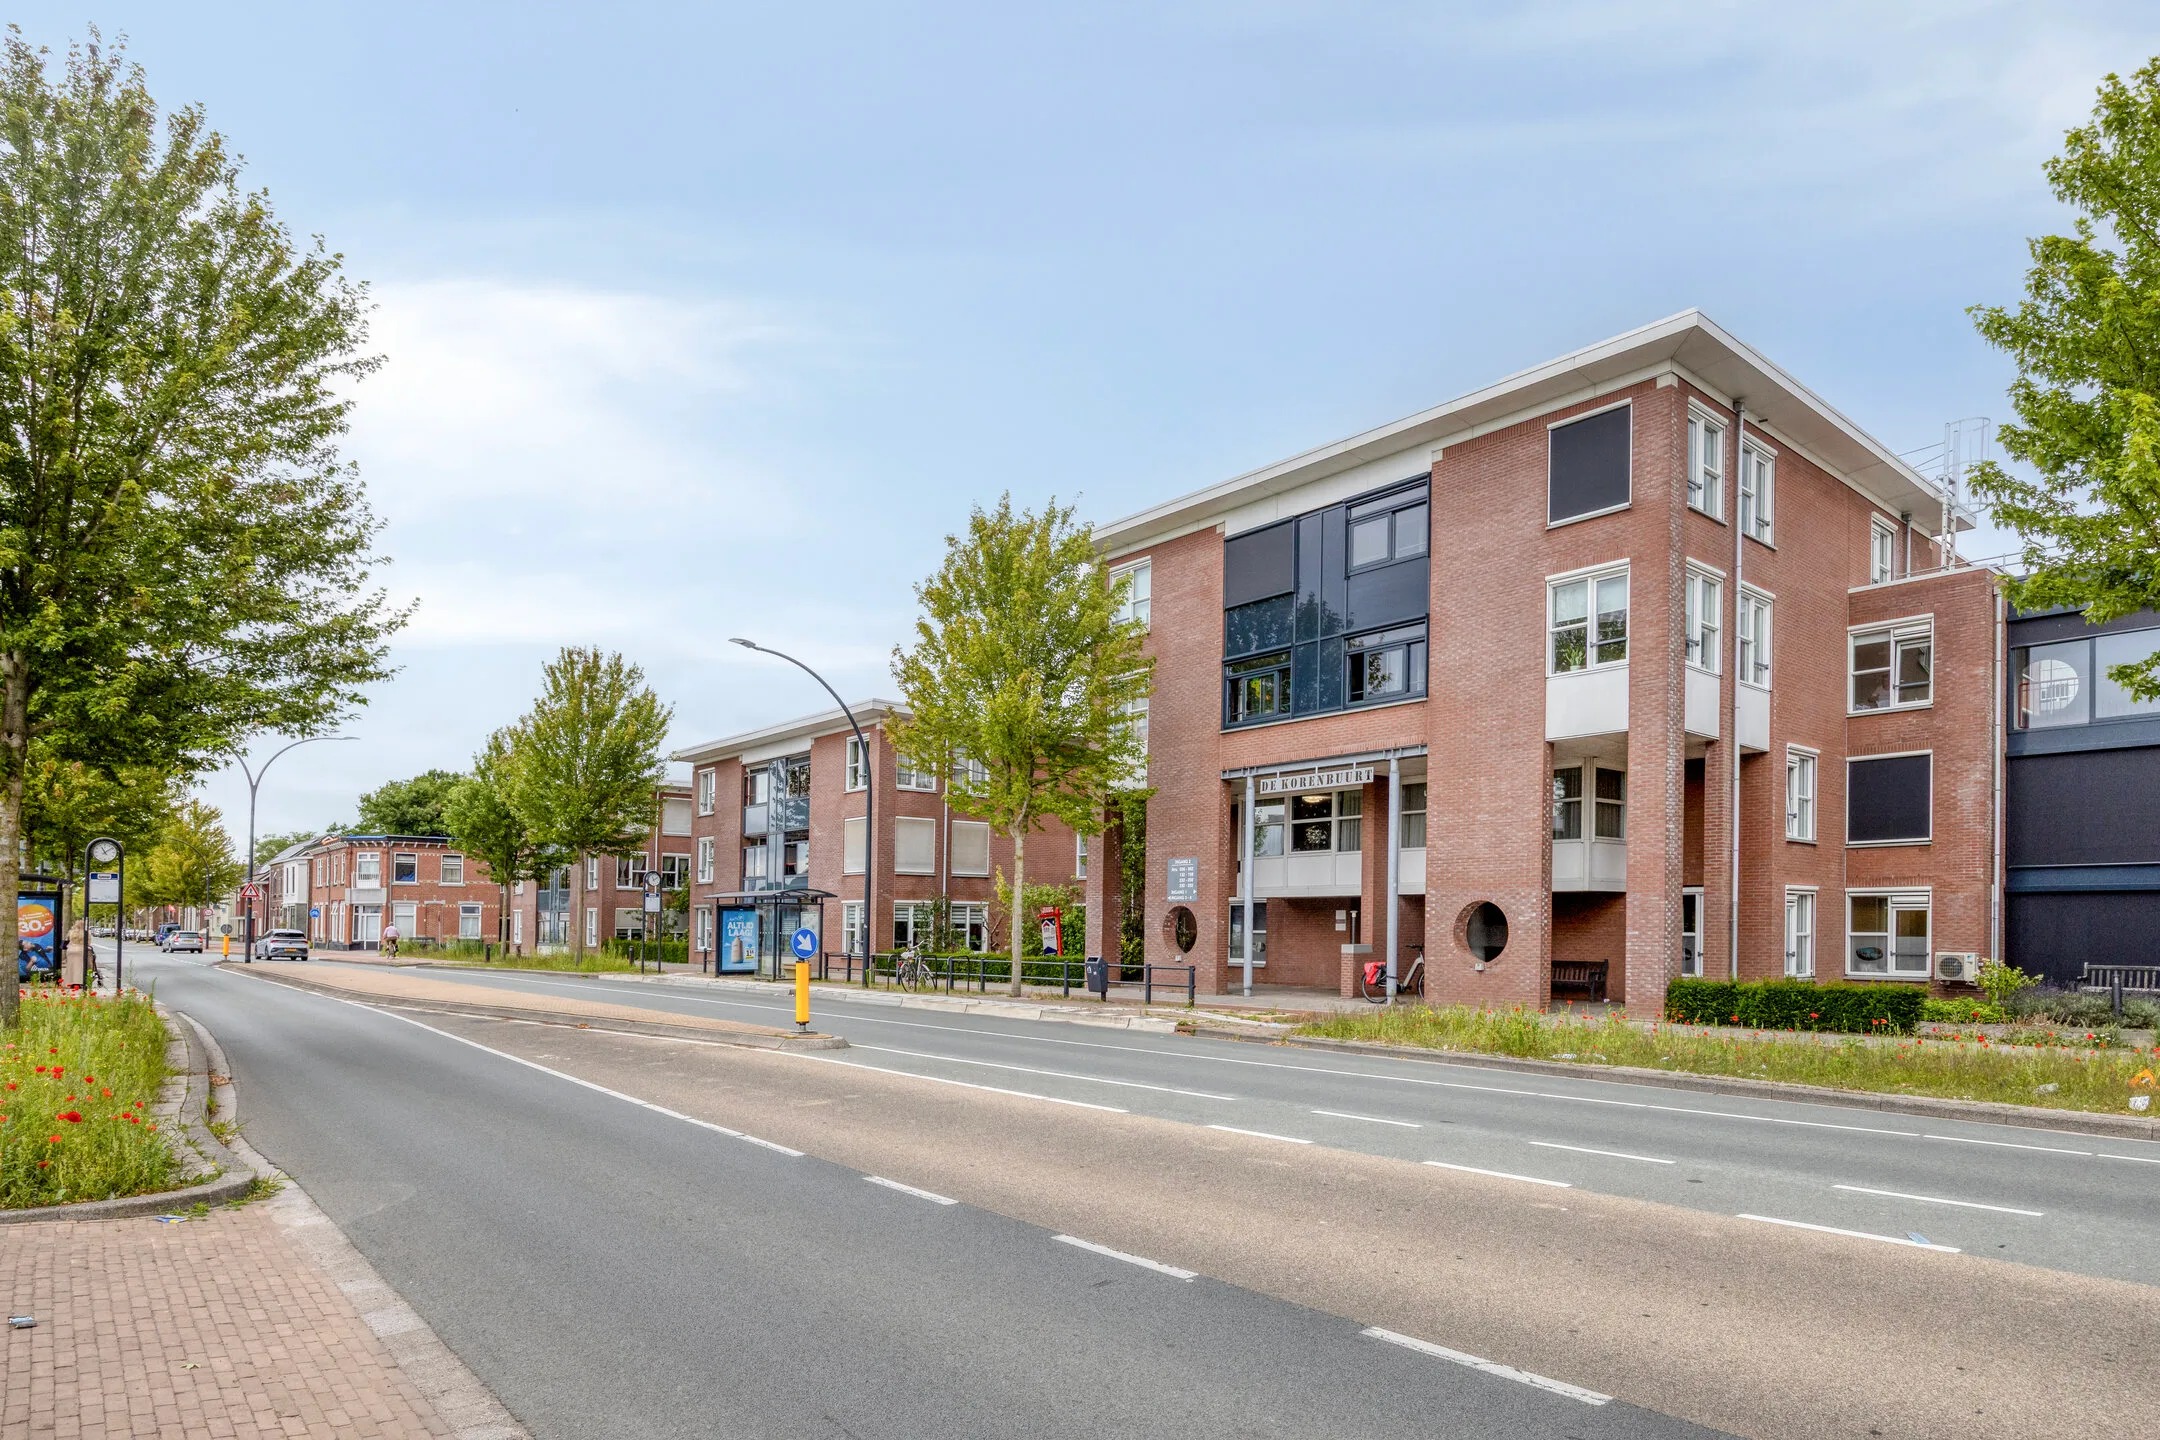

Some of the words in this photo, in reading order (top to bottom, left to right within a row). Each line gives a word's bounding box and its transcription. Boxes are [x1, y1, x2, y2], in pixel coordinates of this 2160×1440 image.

[1262, 780, 1277, 792] DE
[1281, 769, 1373, 790] KORENBUURT
[728, 921, 753, 930] ALTIJD
